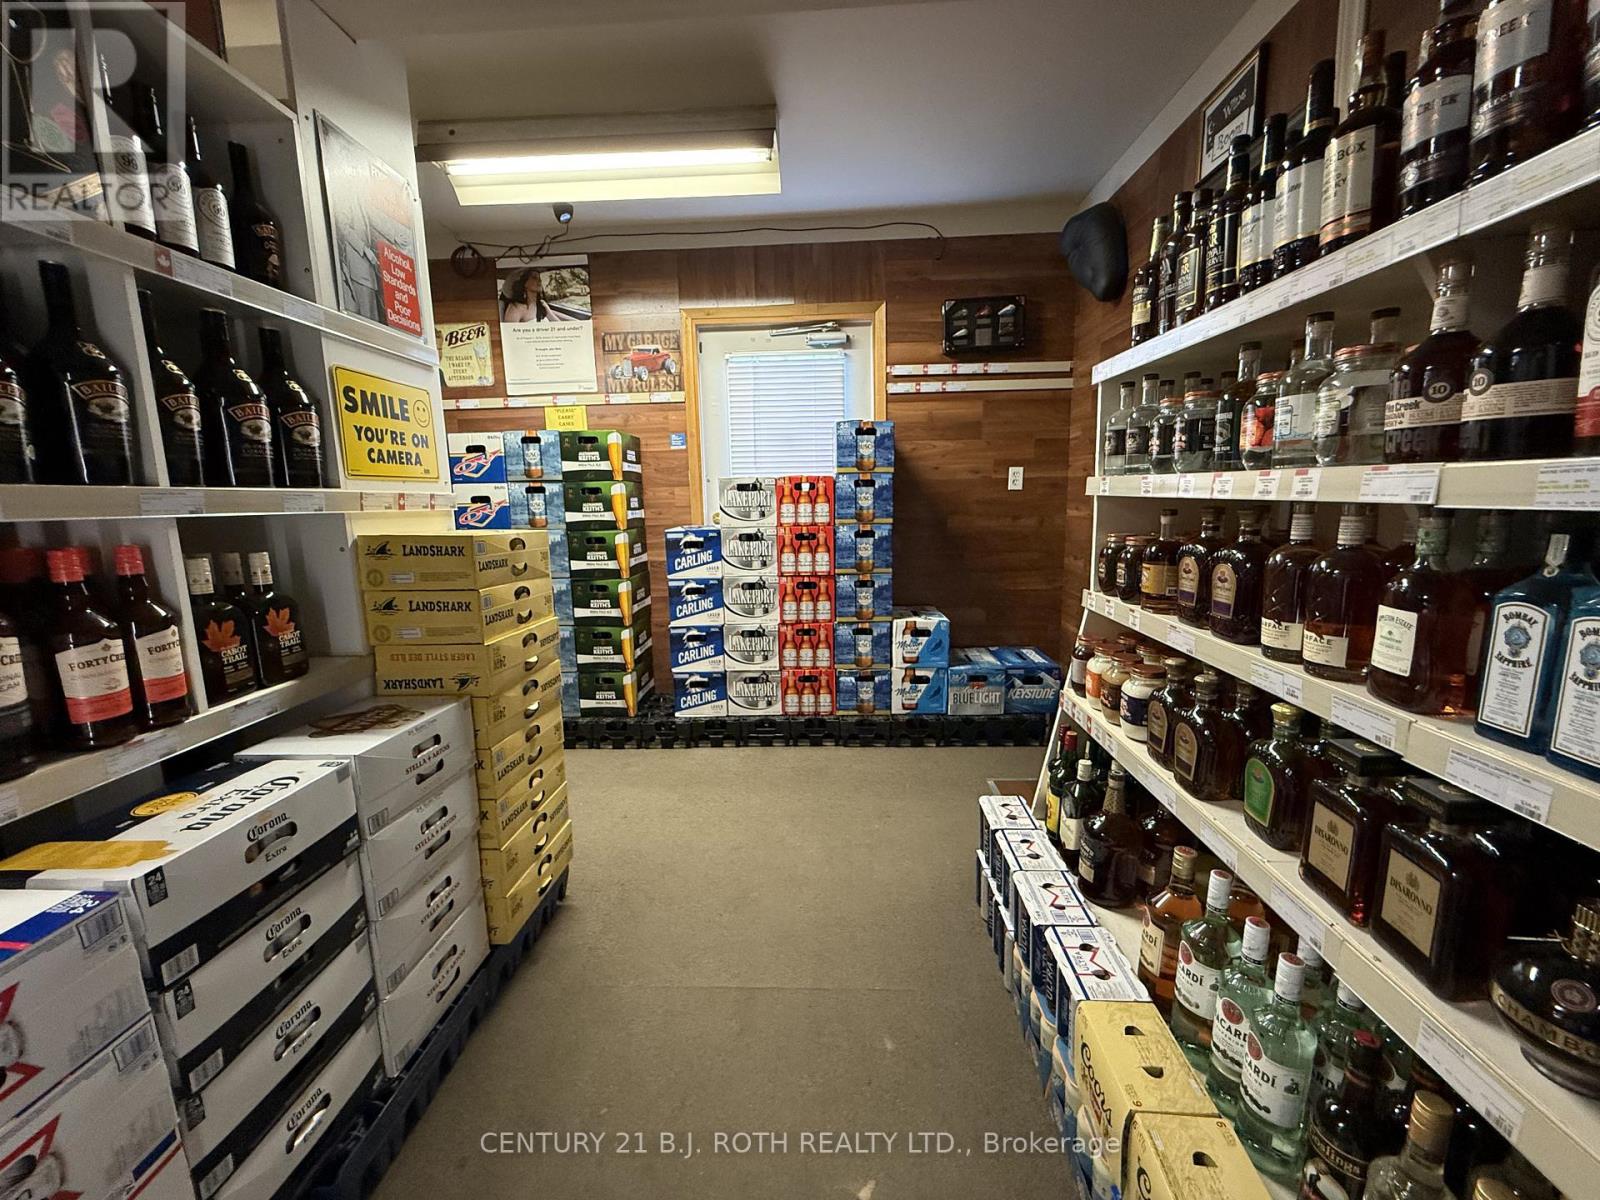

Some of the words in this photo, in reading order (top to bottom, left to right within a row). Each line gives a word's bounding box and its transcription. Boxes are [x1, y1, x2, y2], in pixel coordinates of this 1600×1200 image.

[391, 264, 406, 280] Low
[382, 270, 416, 296] Standards
[394, 289, 409, 304] and
[394, 301, 411, 317] Poor
[387, 310, 421, 332] Decisions
[445, 325, 486, 346] BEER
[605, 334, 626, 351] MY
[627, 332, 678, 349] GARAGE
[608, 379, 629, 393] MY
[633, 375, 679, 392] RULES!
[1431, 384, 1447, 394] 10
[1474, 376, 1484, 386] 10
[343, 385, 410, 422] SMILE
[353, 424, 406, 446] YOU'RE
[411, 433, 429, 448] ON
[367, 448, 422, 466] CAMERA
[724, 489, 772, 507] LAKEPORT
[402, 544, 465, 557] LANDSHARK
[726, 540, 772, 556] LAKEPORT
[478, 558, 508, 573] LANDSHARK
[674, 550, 712, 571] CARLING
[728, 588, 775, 604] LAKEPORT
[409, 600, 472, 612] LANDSHARK
[676, 597, 714, 618] CARLING
[485, 608, 514, 626] LANDSHARK
[1502, 611, 1538, 628] BOMBAY
[279, 630, 300, 641] CABOT
[1579, 627, 1600, 640] BOM
[147, 642, 175, 656] FORTY
[280, 639, 300, 648] TRAIL
[729, 635, 773, 650] LAKEPORT
[221, 645, 248, 658] CABOT
[222, 654, 248, 664] TRAIL
[678, 645, 715, 664] CARLING
[1495, 651, 1533, 668] SAPPHIRE
[68, 656, 110, 671] FORTY
[384, 678, 444, 689] LANDSHARK
[733, 681, 776, 697] LAKEPORT
[680, 690, 716, 708] CARLING
[953, 692, 973, 704] BLUE
[973, 692, 1001, 704] LIGHT
[1007, 688, 1056, 699] KEYSTONE
[405, 758, 427, 775] STELLA
[497, 753, 525, 781] LANDSHARK
[177, 788, 242, 820] Extra
[179, 776, 300, 832] Corona
[502, 801, 528, 831] LANDSHARK
[247, 812, 288, 842] Corona
[415, 830, 436, 851] STELLA
[1315, 825, 1348, 855] DISARONNO
[265, 846, 287, 862] Extra
[147, 874, 163, 887] 24
[1390, 877, 1432, 915] DISARONNO
[266, 908, 301, 941] Corona
[282, 939, 302, 959] Extra
[1073, 951, 1090, 972] ULTRA
[176, 985, 190, 1000] 24
[276, 1000, 313, 1040] Corona
[286, 1088, 322, 1132] Corona
